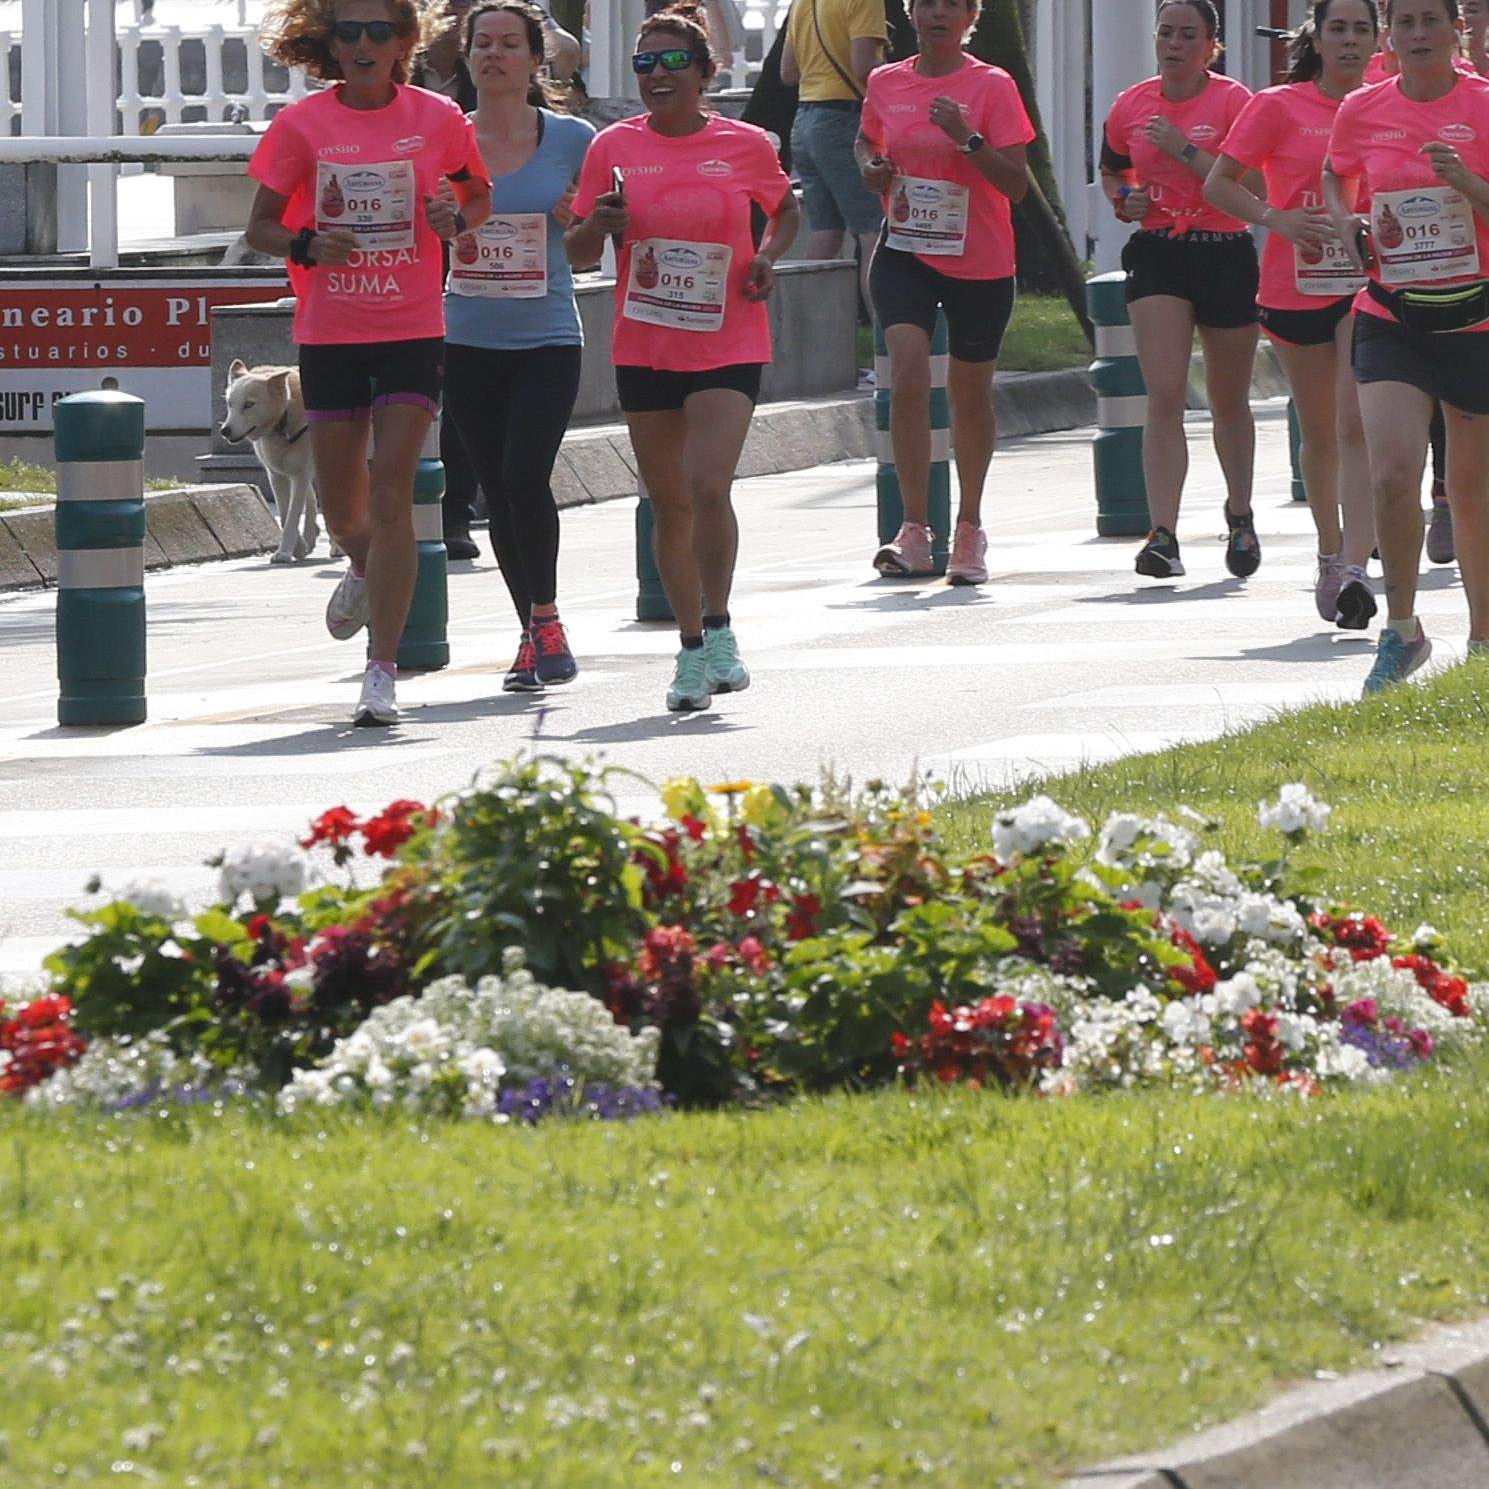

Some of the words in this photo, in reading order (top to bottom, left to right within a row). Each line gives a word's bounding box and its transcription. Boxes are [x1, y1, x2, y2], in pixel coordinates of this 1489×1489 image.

[318, 144, 361, 157] OYSHO
[348, 199, 381, 211] 016
[912, 208, 938, 220] 016
[1406, 224, 1440, 239] 016
[1414, 241, 1434, 250] 3777
[481, 246, 513, 258] 016
[328, 273, 401, 295] SUMA
[661, 273, 695, 289] 016
[667, 290, 684, 299] 315
[2, 297, 143, 327] neario
